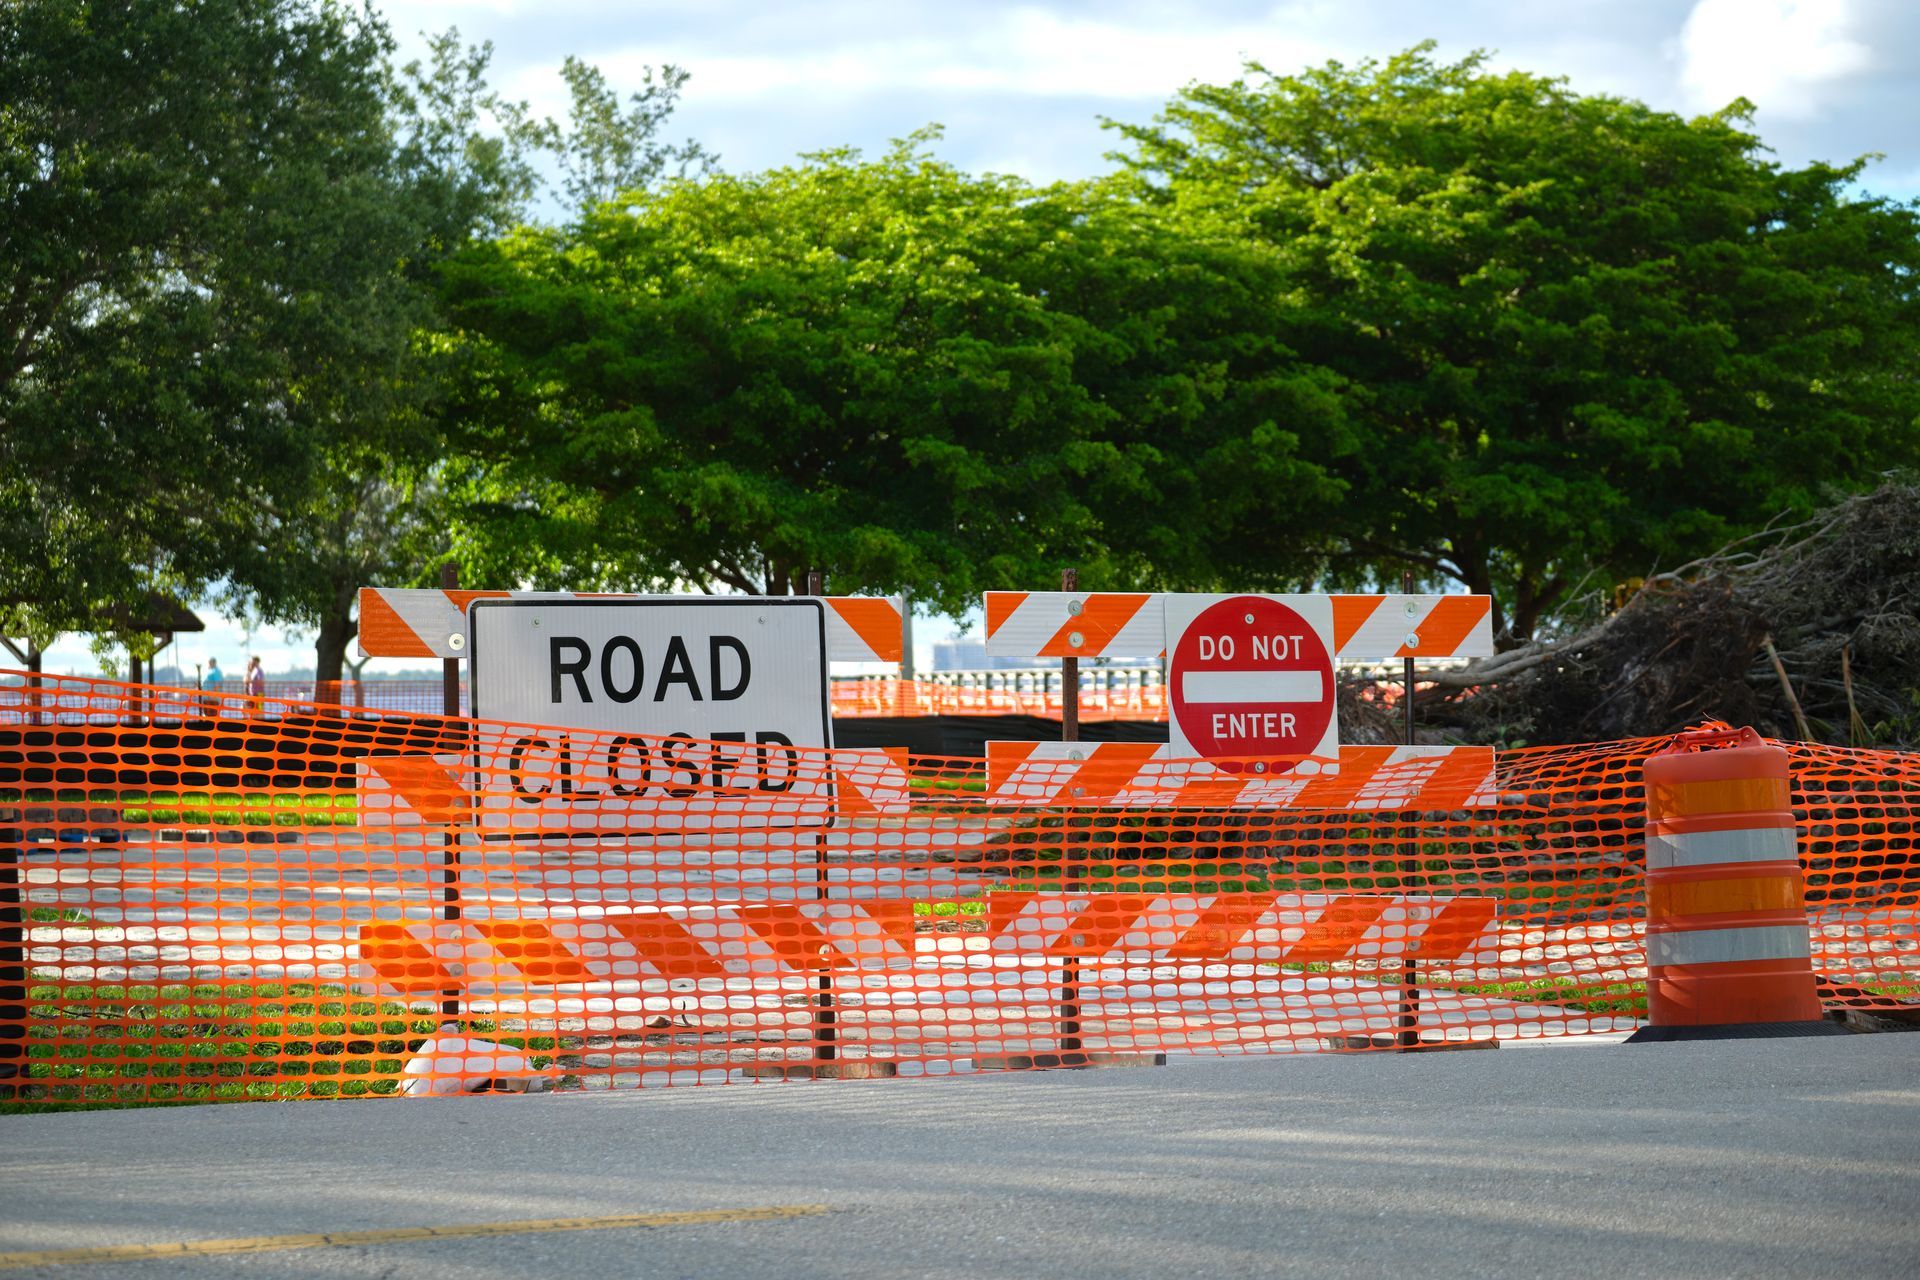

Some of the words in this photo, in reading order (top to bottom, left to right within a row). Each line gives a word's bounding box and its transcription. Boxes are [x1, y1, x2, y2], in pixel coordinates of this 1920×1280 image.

[550, 635, 751, 703] ROAD
[1199, 635, 1235, 660] DO
[1252, 635, 1303, 660] NOT
[1212, 713, 1297, 738] ENTER
[509, 731, 798, 804] CLOSED
